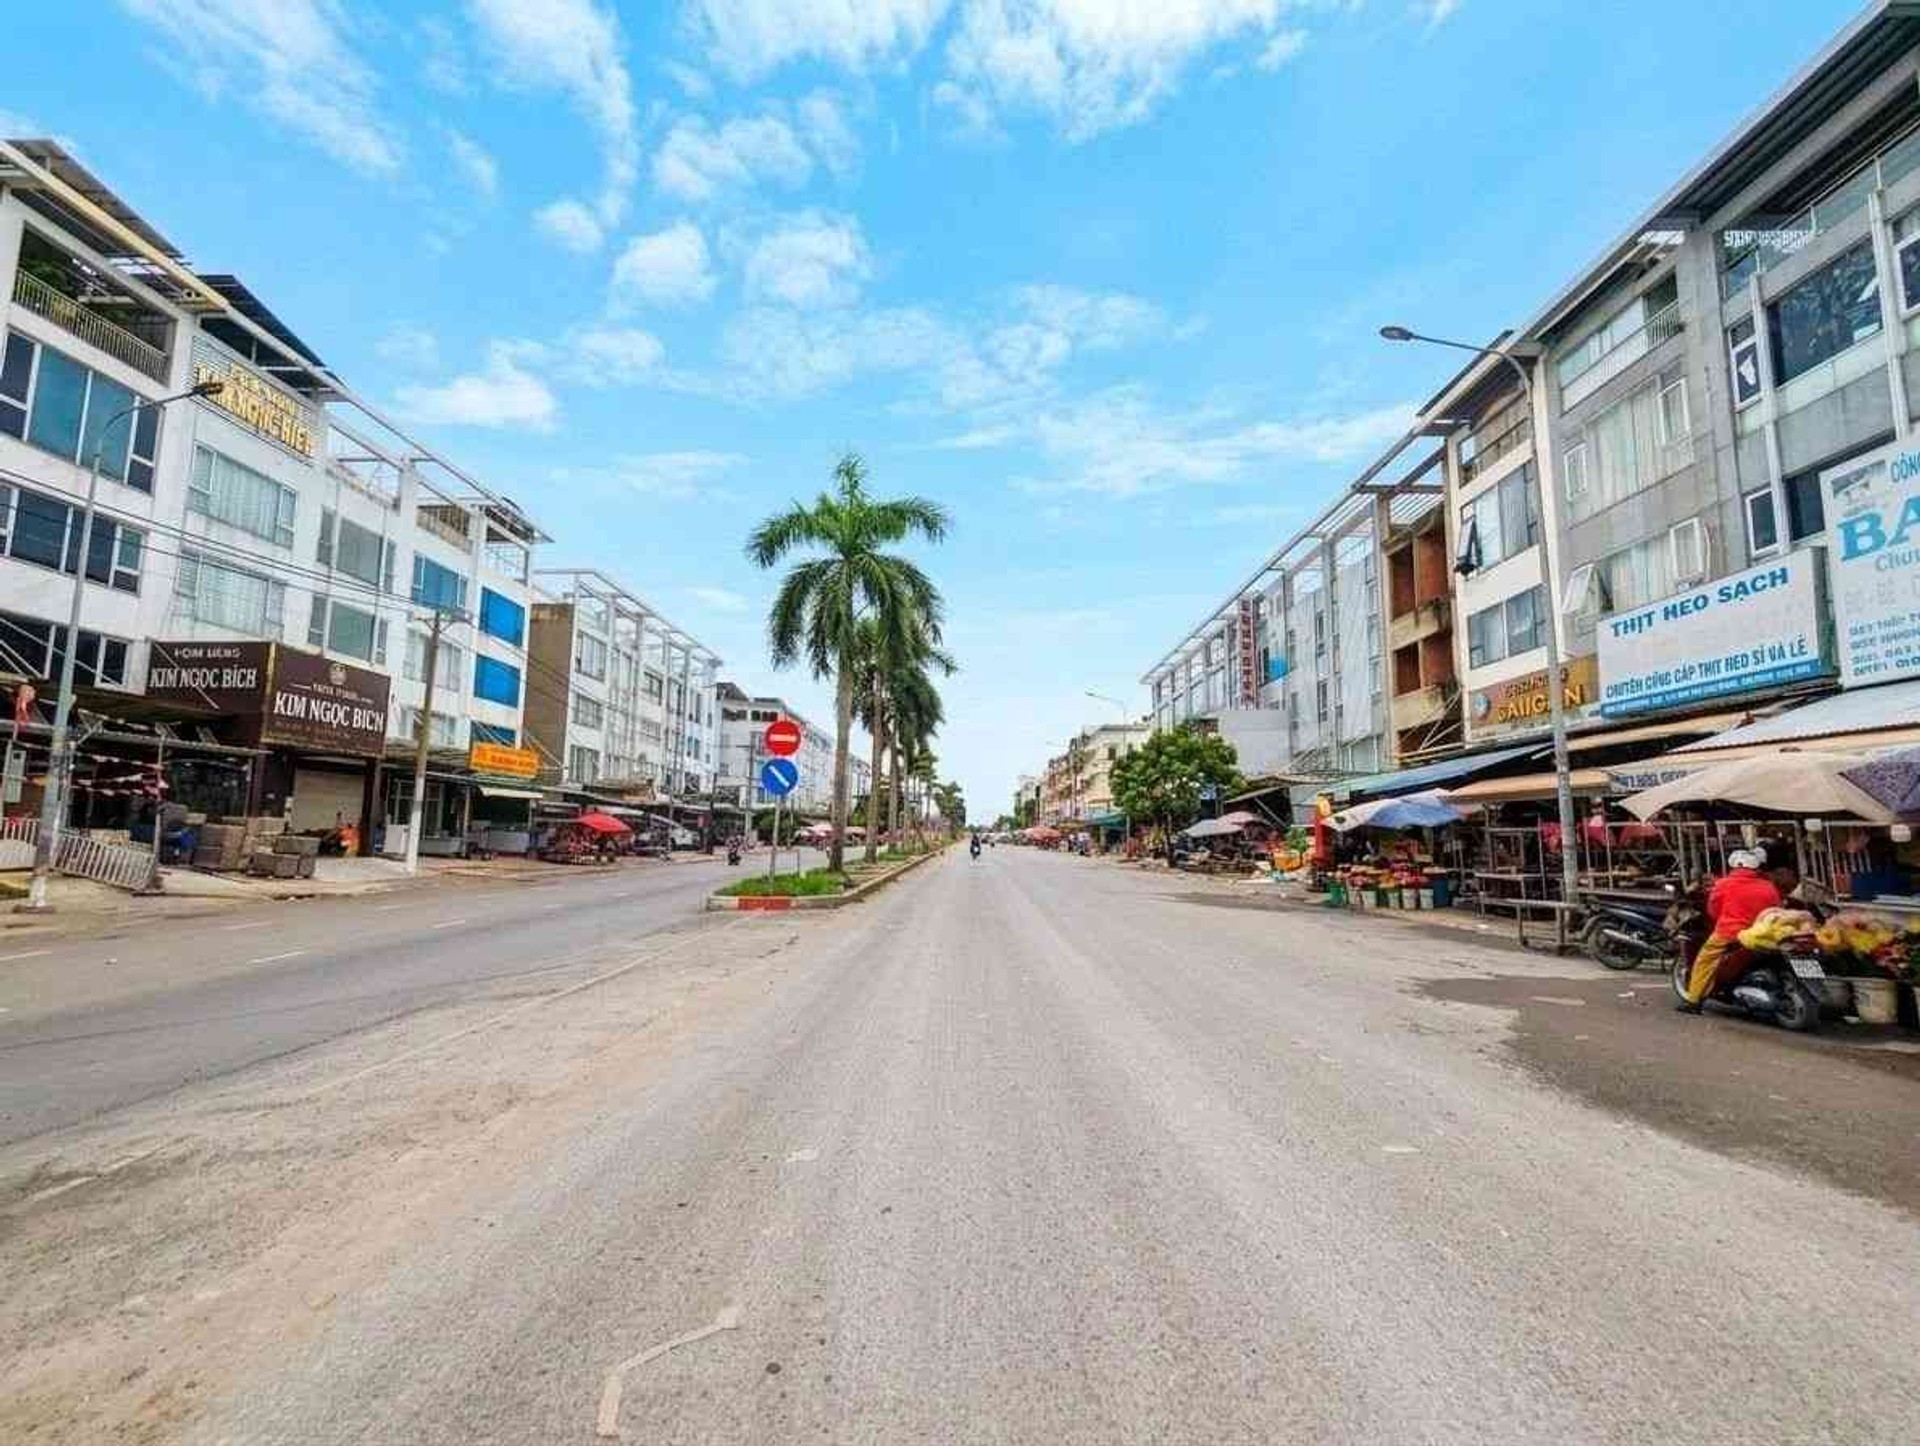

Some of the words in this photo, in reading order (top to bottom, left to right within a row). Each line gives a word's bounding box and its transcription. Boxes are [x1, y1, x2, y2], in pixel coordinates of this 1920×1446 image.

[1663, 594, 1709, 621] HEO
[1717, 567, 1789, 603] SẠCH
[149, 667, 178, 688] KIM
[273, 690, 307, 718] KIM
[309, 698, 350, 729] NGỌC
